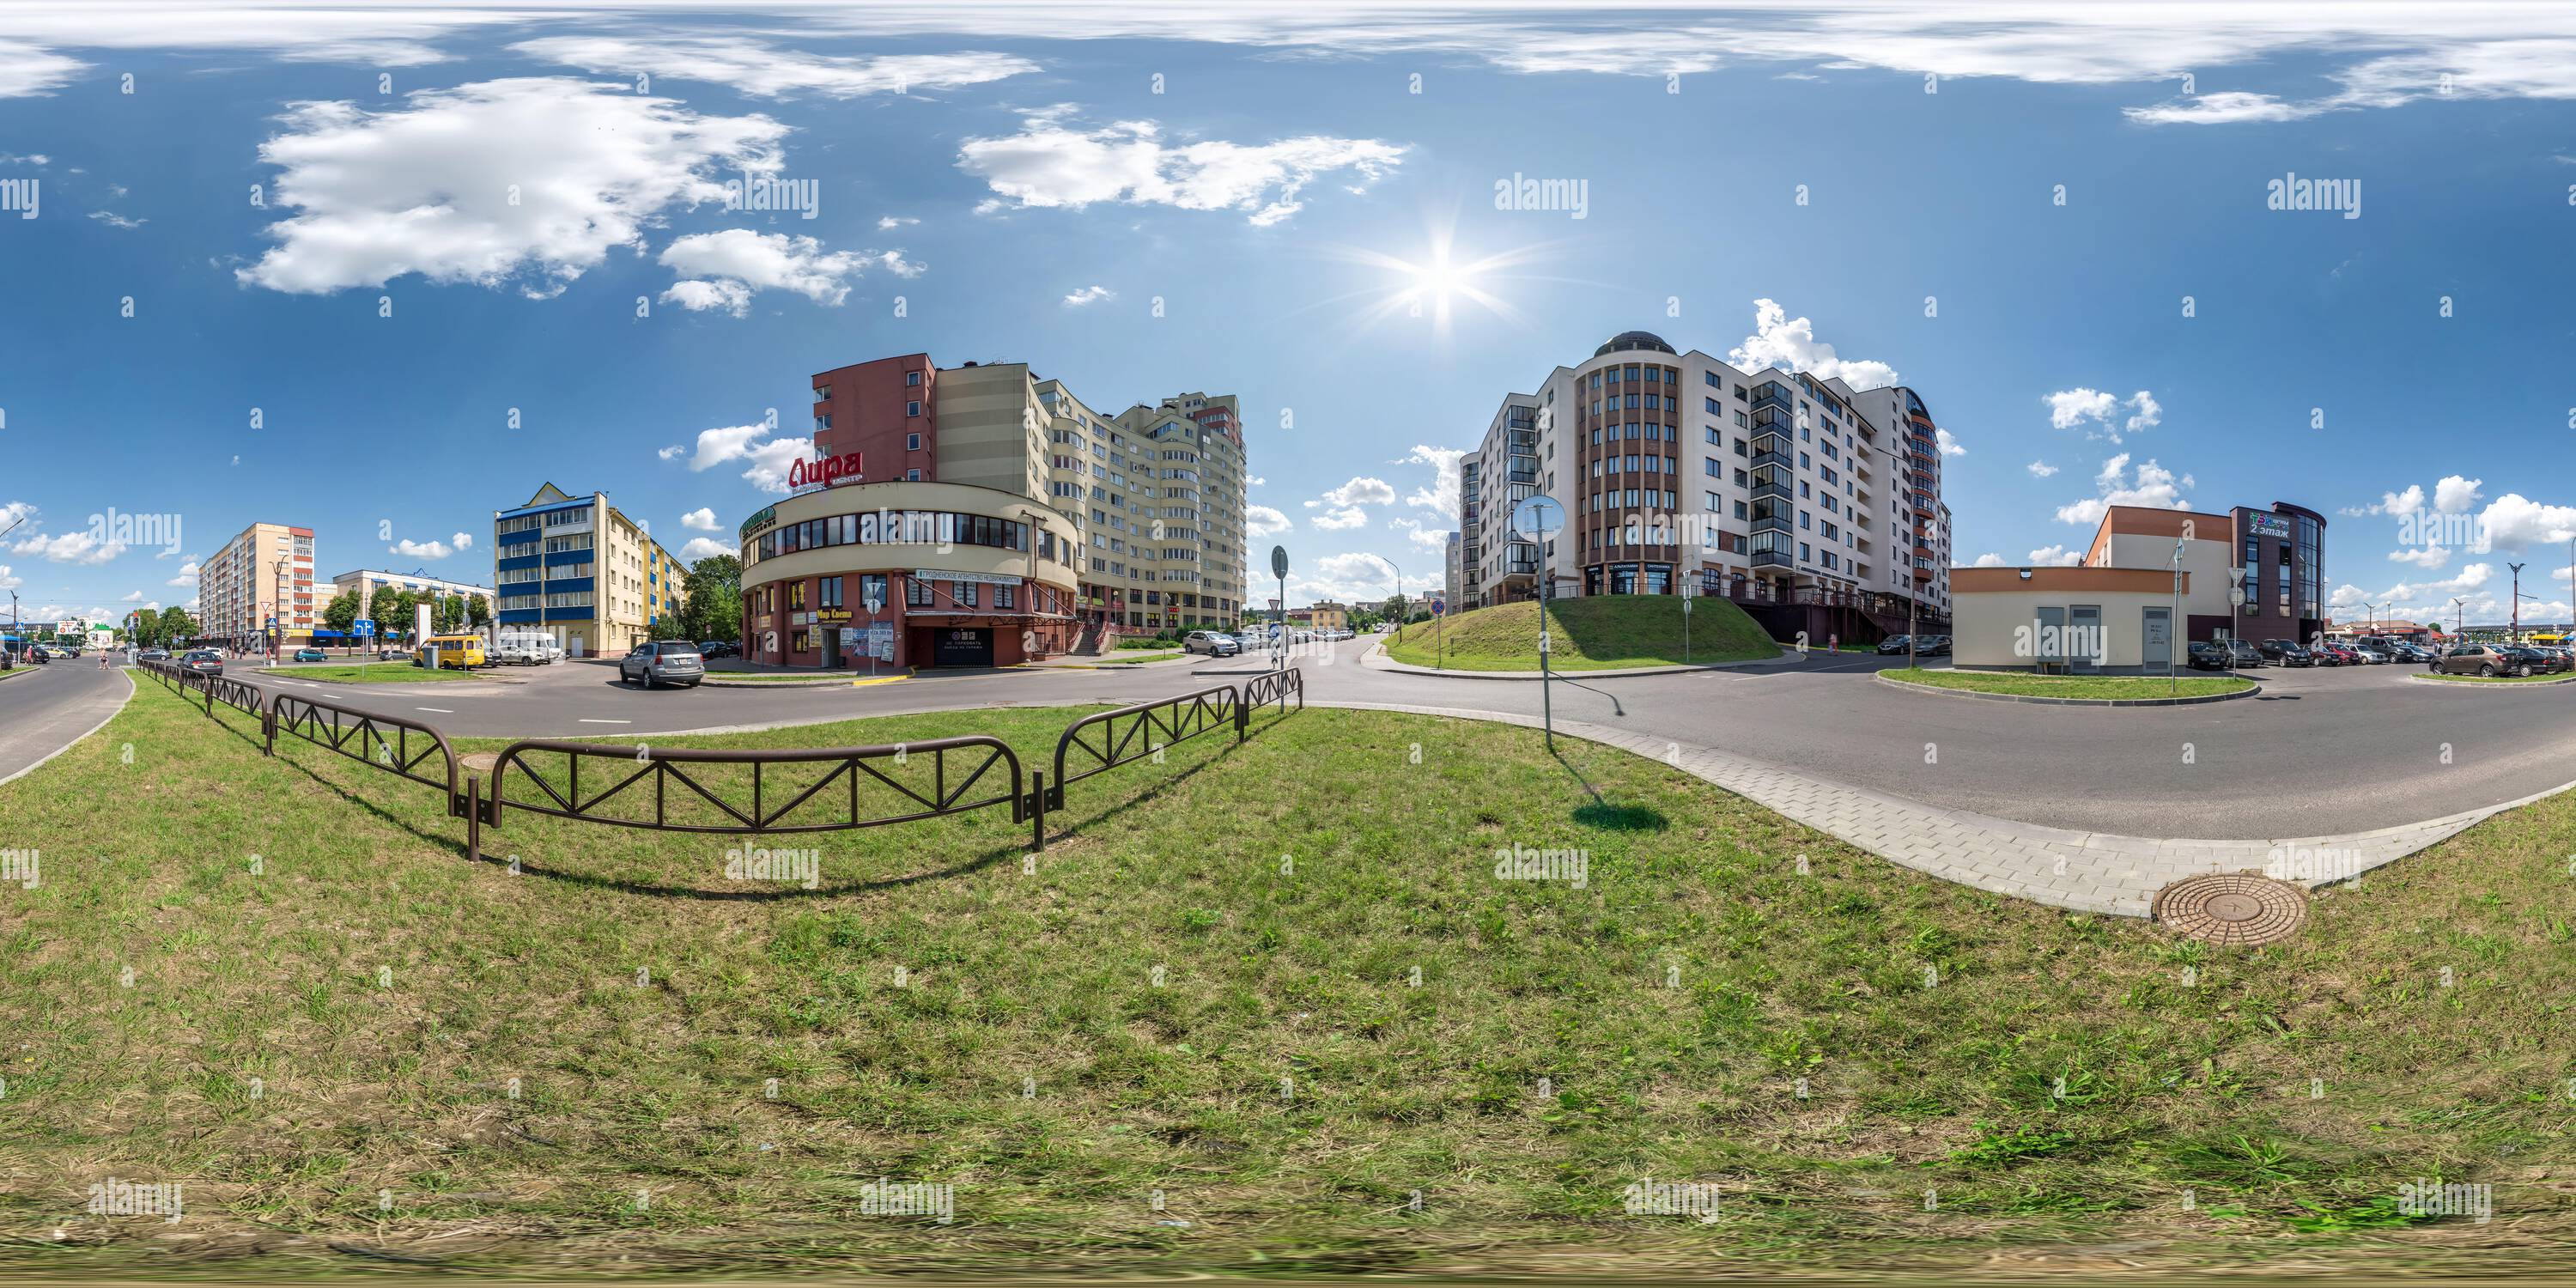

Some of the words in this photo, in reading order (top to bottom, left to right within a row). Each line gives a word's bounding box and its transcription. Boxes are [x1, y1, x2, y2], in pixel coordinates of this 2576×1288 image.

[2251, 525, 2257, 533] 2
[2259, 526, 2289, 538] этаж
[923, 570, 957, 580] ГРОДНЕНСКОЕ
[957, 573, 983, 581] АГЕНТСТВО
[984, 575, 1019, 584] НЕДВИЖИМОСТИ
[817, 610, 829, 619] Мир
[831, 608, 853, 618] Света
